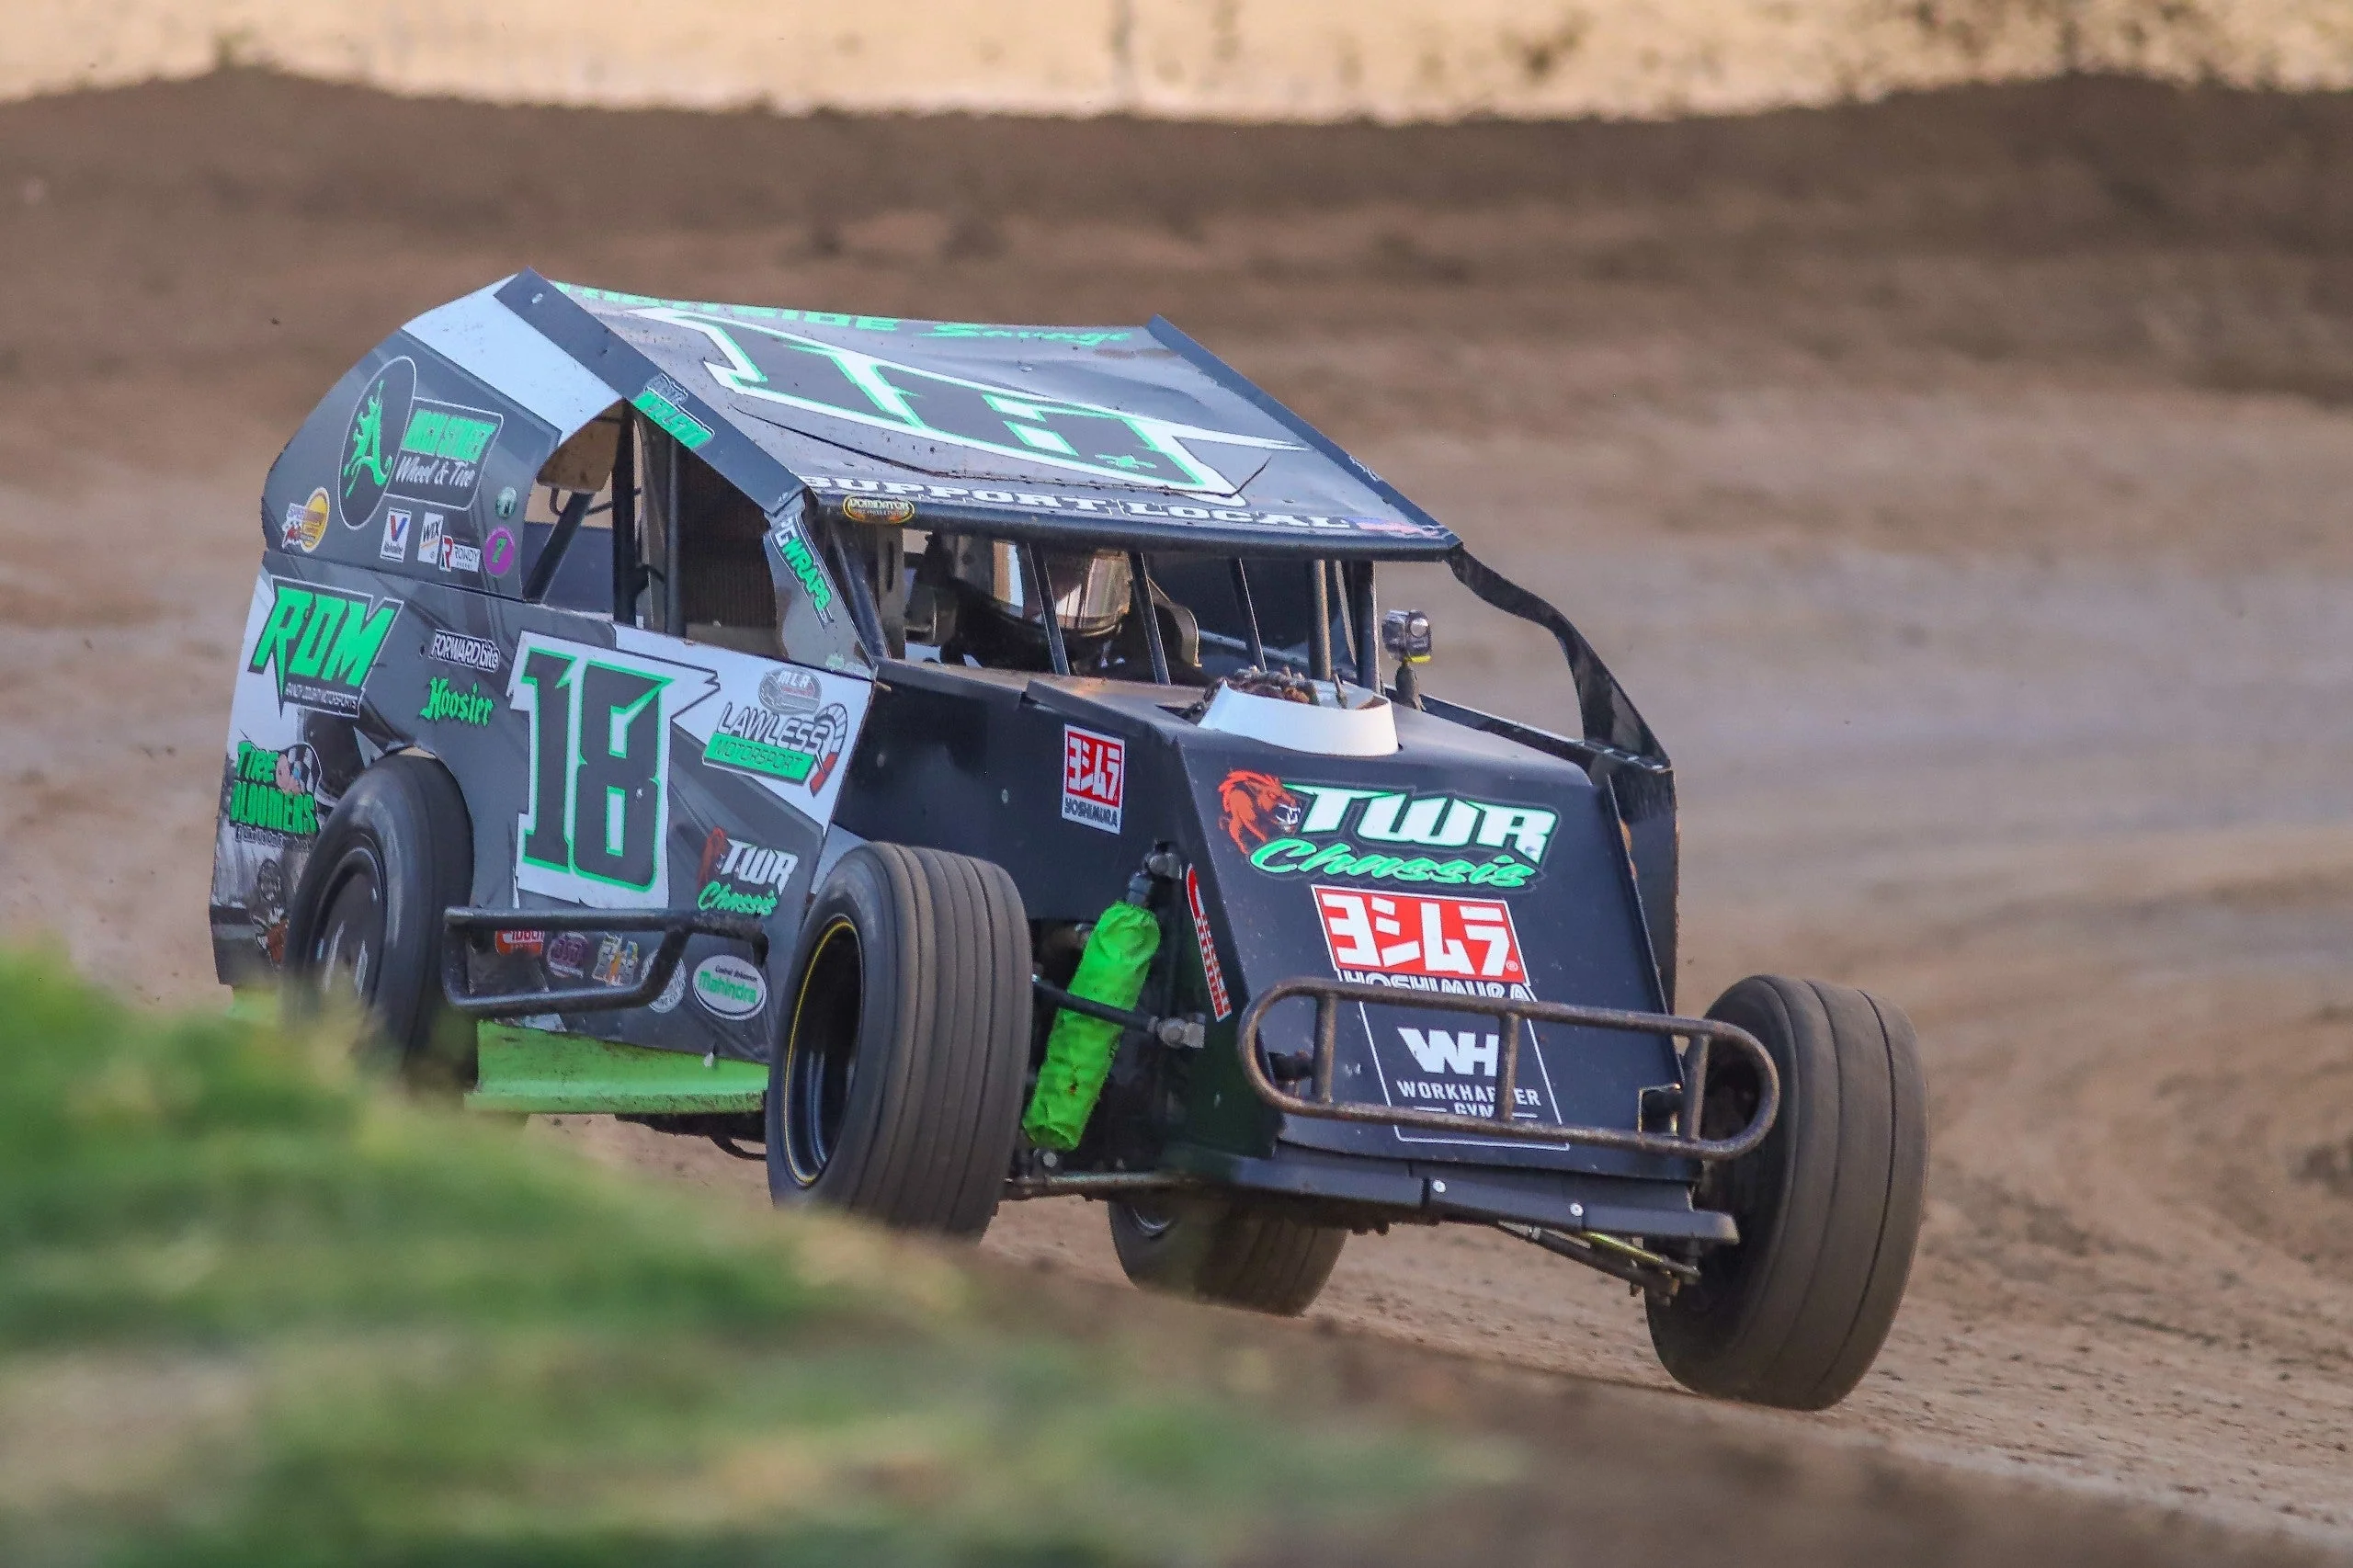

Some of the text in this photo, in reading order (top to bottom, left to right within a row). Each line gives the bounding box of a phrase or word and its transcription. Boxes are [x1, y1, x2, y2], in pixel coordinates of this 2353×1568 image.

[801, 474, 1351, 529] SUPPORT LOCAL
[423, 520, 443, 541] WIX
[252, 585, 395, 699] RDM
[420, 676, 494, 727] Hoosier
[717, 701, 831, 754] LAWLESS
[236, 741, 279, 783] TIRE
[520, 646, 675, 892] 18
[1283, 783, 1557, 864] TWR
[721, 838, 799, 895] TWR
[1250, 837, 1536, 887] Chassis
